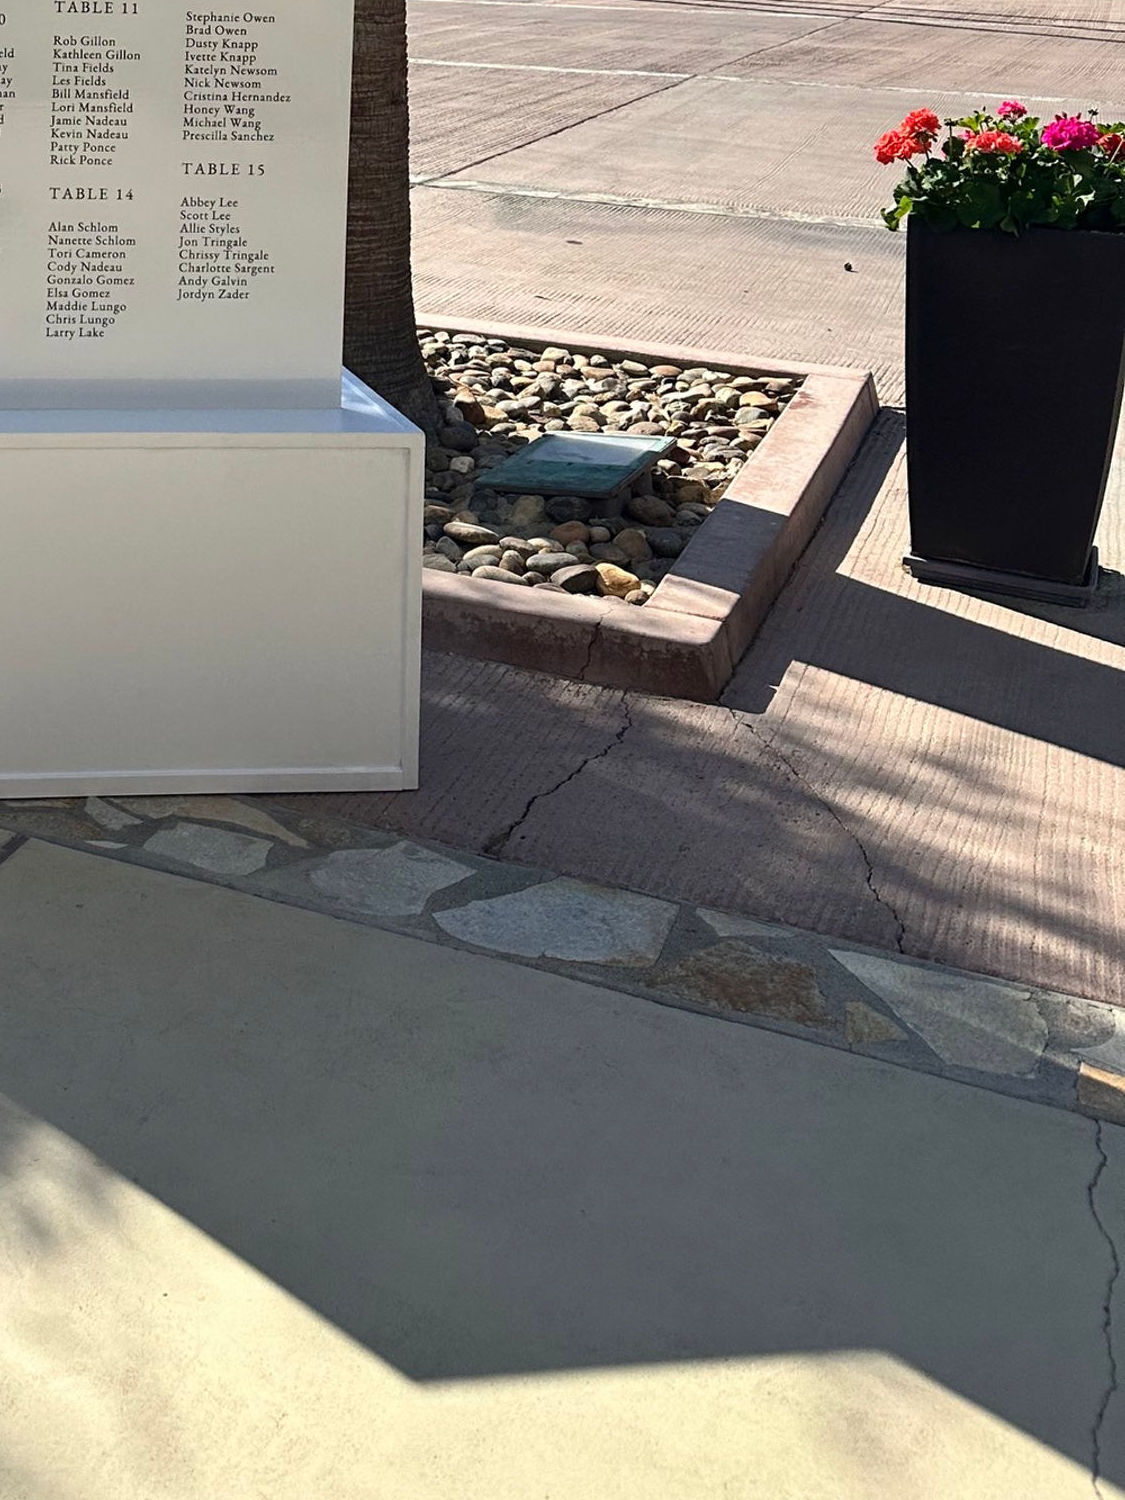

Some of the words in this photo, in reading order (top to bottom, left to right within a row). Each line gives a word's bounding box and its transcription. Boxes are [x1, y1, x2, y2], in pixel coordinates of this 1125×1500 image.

[54, 0, 114, 14] TABLE
[122, 3, 138, 15] 11
[53, 35, 78, 47] Rob
[80, 36, 116, 47] Gillon
[185, 51, 217, 62] Ivette
[220, 51, 257, 66] Knapp
[185, 64, 227, 80] Katelyn
[230, 65, 278, 76] Newsom
[52, 88, 71, 99] Bill
[74, 88, 129, 100] Mansfield
[184, 91, 228, 102] Cristina
[232, 91, 291, 103] Hernandez
[51, 128, 83, 139] Kevin
[86, 128, 129, 140] Nadeau
[183, 130, 228, 141] Prescilla
[231, 129, 274, 142] Sanchez
[182, 163, 240, 176] TABLE
[248, 164, 265, 176] 15
[49, 187, 108, 200] TABLE
[117, 189, 134, 201] 14
[180, 197, 216, 211] Abbey
[219, 197, 238, 208] Lee
[179, 222, 206, 234] Allie
[208, 223, 240, 237] Styles
[48, 235, 93, 246] Nanette
[95, 235, 136, 246] Schlom
[48, 248, 72, 259] Tori
[75, 248, 126, 259] Cameron
[179, 262, 232, 273] Charlotte
[234, 262, 275, 277] Sargent
[47, 274, 94, 285] Gonzalo
[96, 274, 135, 286] Gomez
[177, 289, 215, 303] Jordyn
[218, 289, 249, 300] Zader
[46, 327, 76, 341] Larry
[79, 327, 105, 338] Lake
